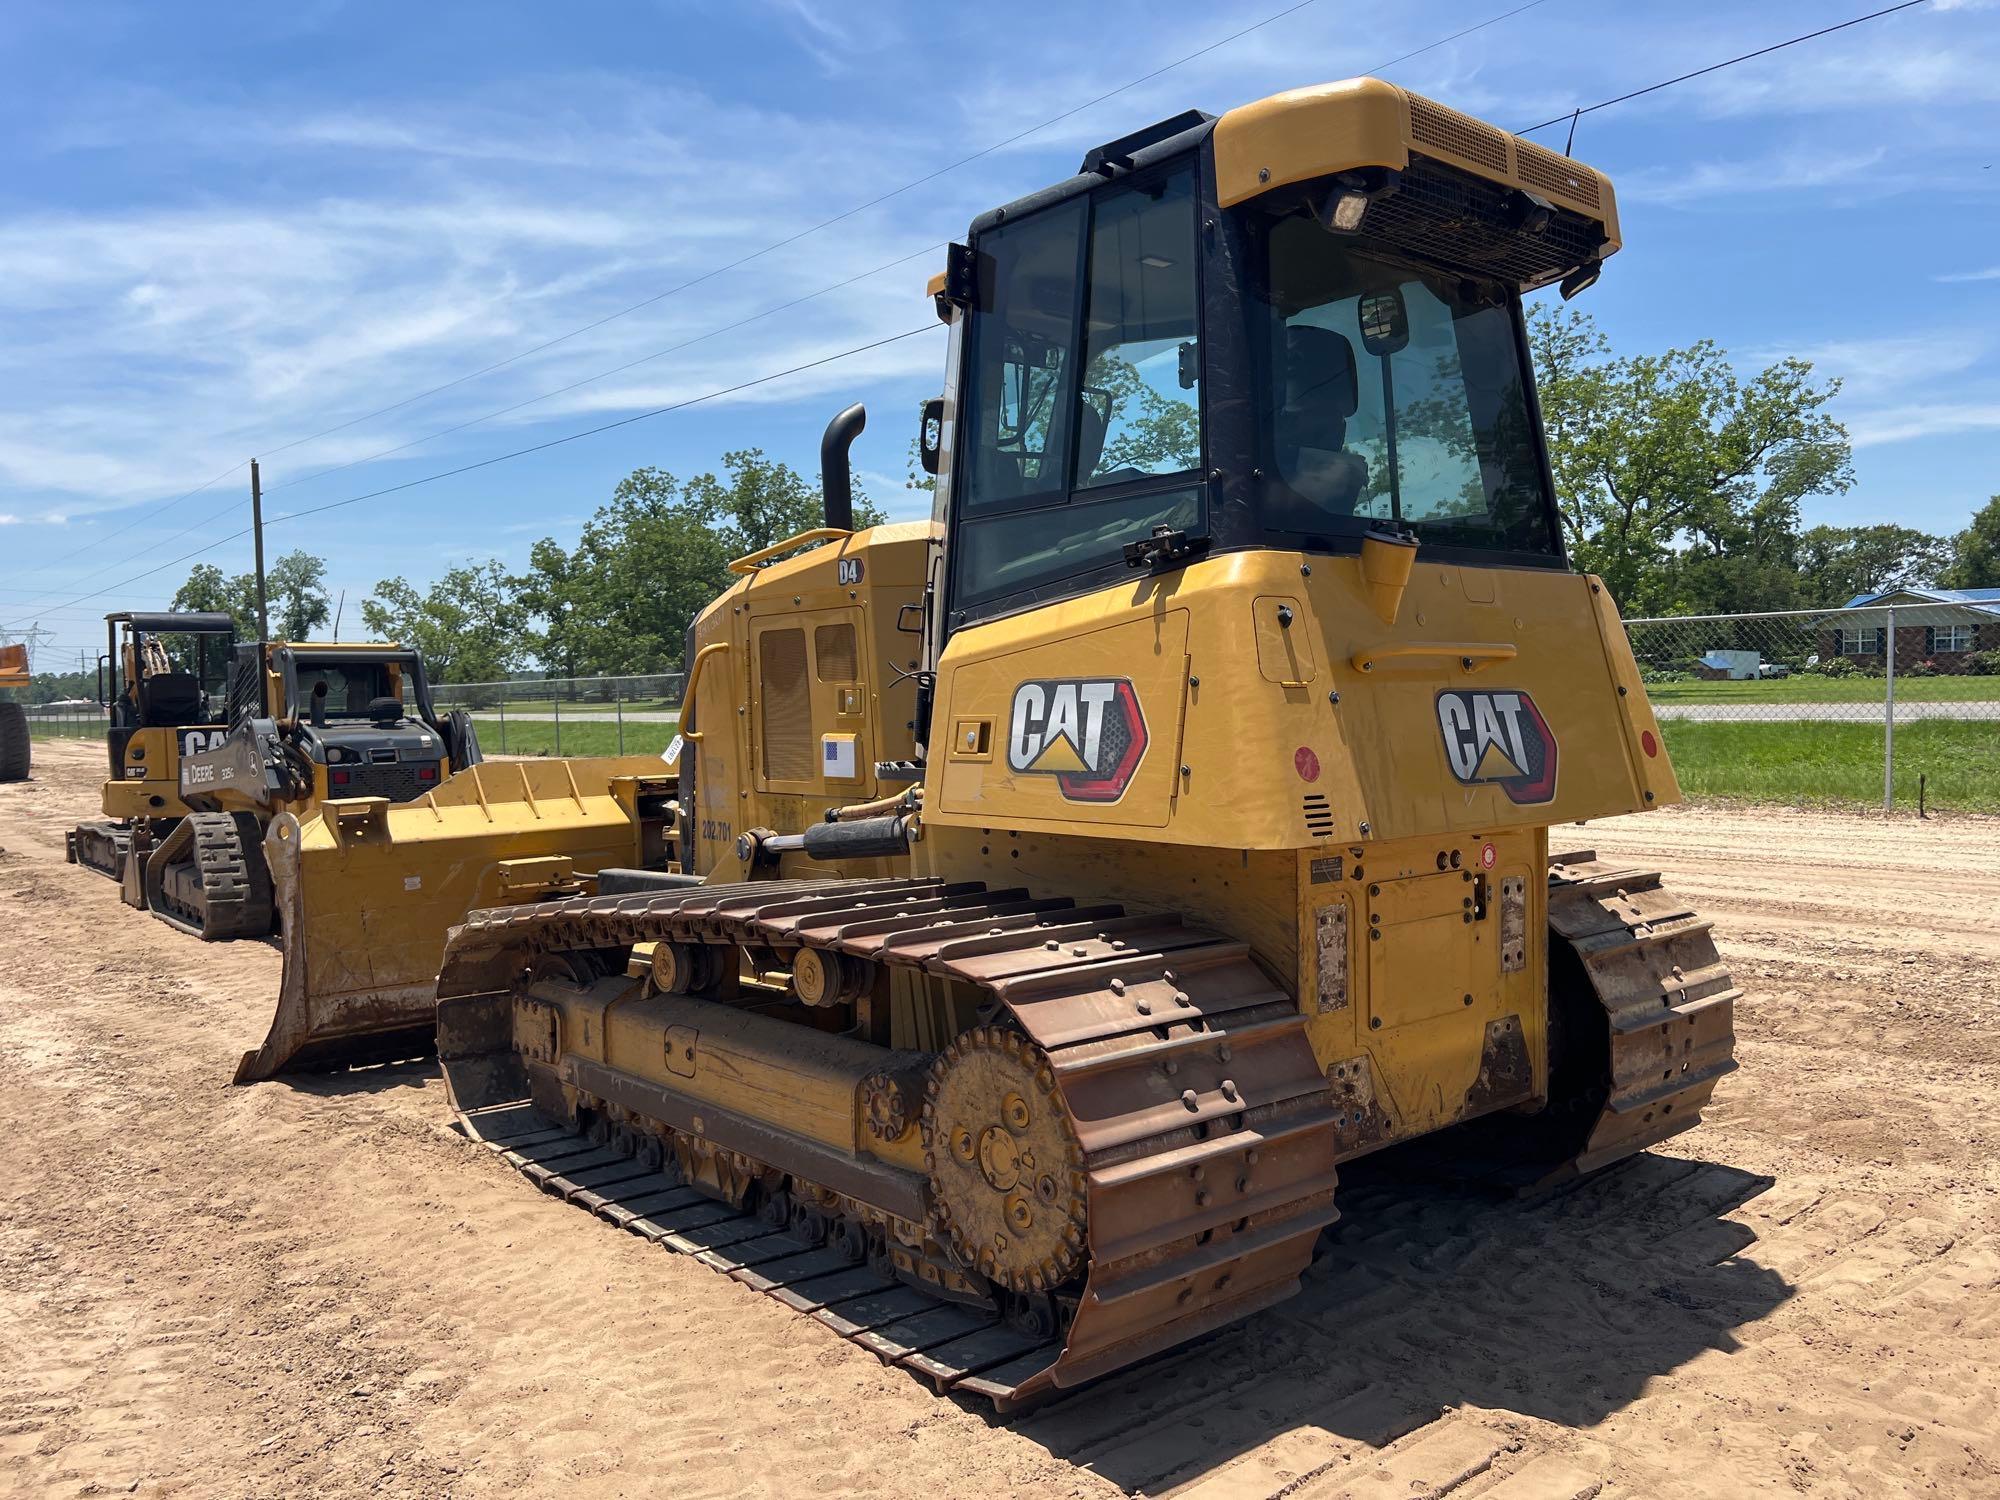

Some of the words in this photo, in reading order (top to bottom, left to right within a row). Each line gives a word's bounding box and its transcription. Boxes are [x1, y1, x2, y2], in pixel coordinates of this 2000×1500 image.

[838, 559, 858, 584] D4
[1010, 683, 1115, 772] CAT
[1438, 693, 1530, 780] CAT
[185, 731, 229, 757] CA
[191, 764, 214, 784] DEERE
